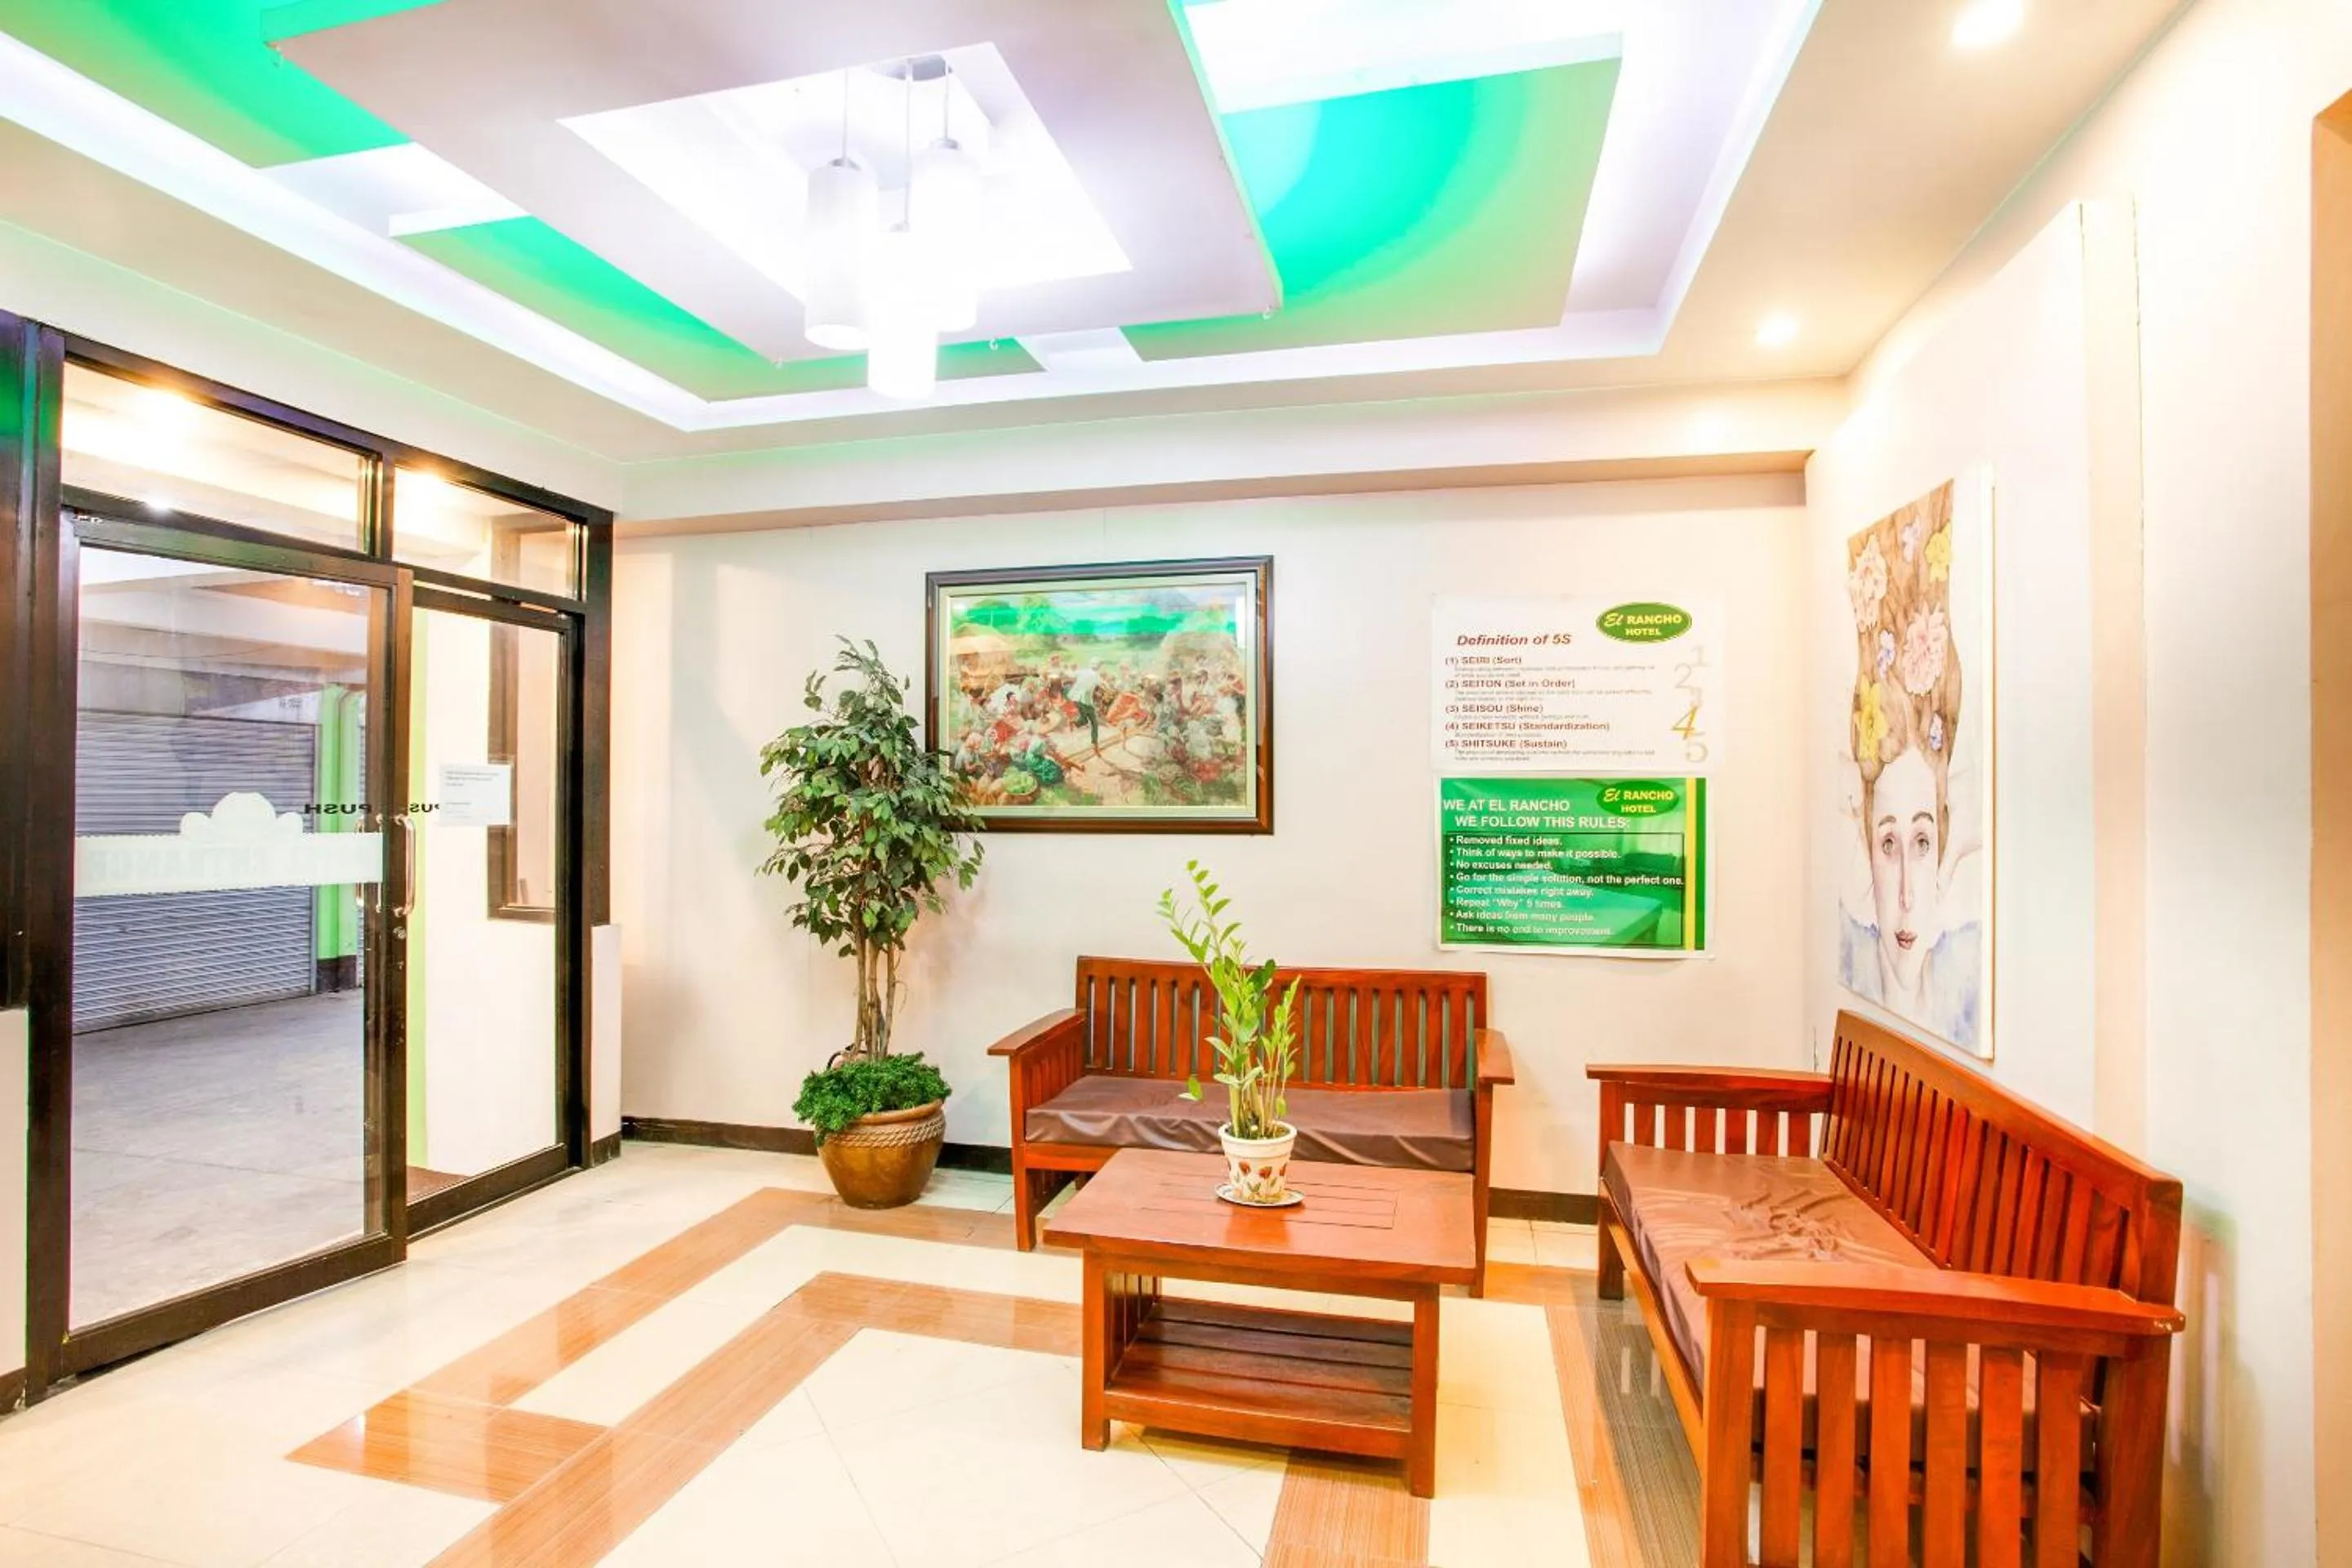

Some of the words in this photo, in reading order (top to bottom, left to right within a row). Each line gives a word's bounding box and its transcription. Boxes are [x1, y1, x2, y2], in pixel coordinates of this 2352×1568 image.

[1603, 612, 1624, 627] El
[1626, 614, 1682, 625] RANCHO
[1624, 627, 1662, 636] HOTEL
[1457, 634, 1528, 646] Definition
[1533, 634, 1548, 645] of
[1552, 634, 1572, 645] 5S
[1445, 656, 1459, 665] (1)
[1492, 656, 1522, 665] (Sort)
[1445, 679, 1459, 688] (2)
[1461, 679, 1502, 688] SEITON
[1504, 679, 1526, 688] (Set
[1445, 704, 1459, 714] (3)
[1461, 704, 1503, 713] SEISOU
[1506, 704, 1544, 714] (Shine)
[1445, 722, 1459, 731] (4)
[1461, 722, 1516, 730] SEIKETSU
[1519, 722, 1610, 731] (Standardization)
[1670, 704, 1699, 740] 4
[1460, 739, 1517, 748] SHITSUKE
[1519, 739, 1567, 749] (Sustain)
[1603, 787, 1619, 802] El
[1623, 791, 1674, 801] RANCHO
[1443, 800, 1465, 811] WE
[1468, 800, 1486, 811] AT
[1489, 800, 1507, 811] EL
[1509, 800, 1570, 812] RANCHO
[1620, 804, 1657, 813] HOTEL
[1454, 816, 1477, 827] WE
[1480, 817, 1539, 828] FOLLOW
[1543, 817, 1575, 828] THIS
[1456, 835, 1503, 845] Removed
[1505, 835, 1530, 845] fixed
[1456, 848, 1483, 857] Think
[1485, 848, 1496, 857] of
[1496, 849, 1522, 860] ways
[1525, 849, 1535, 858] to
[1537, 849, 1564, 858] make
[1566, 849, 1574, 858] it
[1456, 860, 1470, 870] No
[1472, 862, 1512, 871] excuses
[1456, 872, 1470, 882] Go
[1472, 872, 1488, 882] for
[1489, 872, 1504, 882] the
[1587, 875, 1603, 884] not
[1606, 875, 1623, 885] the
[1624, 875, 1660, 887] perfect
[1456, 885, 1493, 895] Correct
[1494, 885, 1538, 895] mistakes
[1541, 886, 1565, 898] right
[1456, 898, 1490, 908] Repeat
[1456, 911, 1474, 920] Ask
[1477, 911, 1501, 920] ideas
[1503, 911, 1528, 920] from
[1456, 924, 1485, 933] There
[1486, 924, 1494, 933] is
[1496, 925, 1510, 934] no
